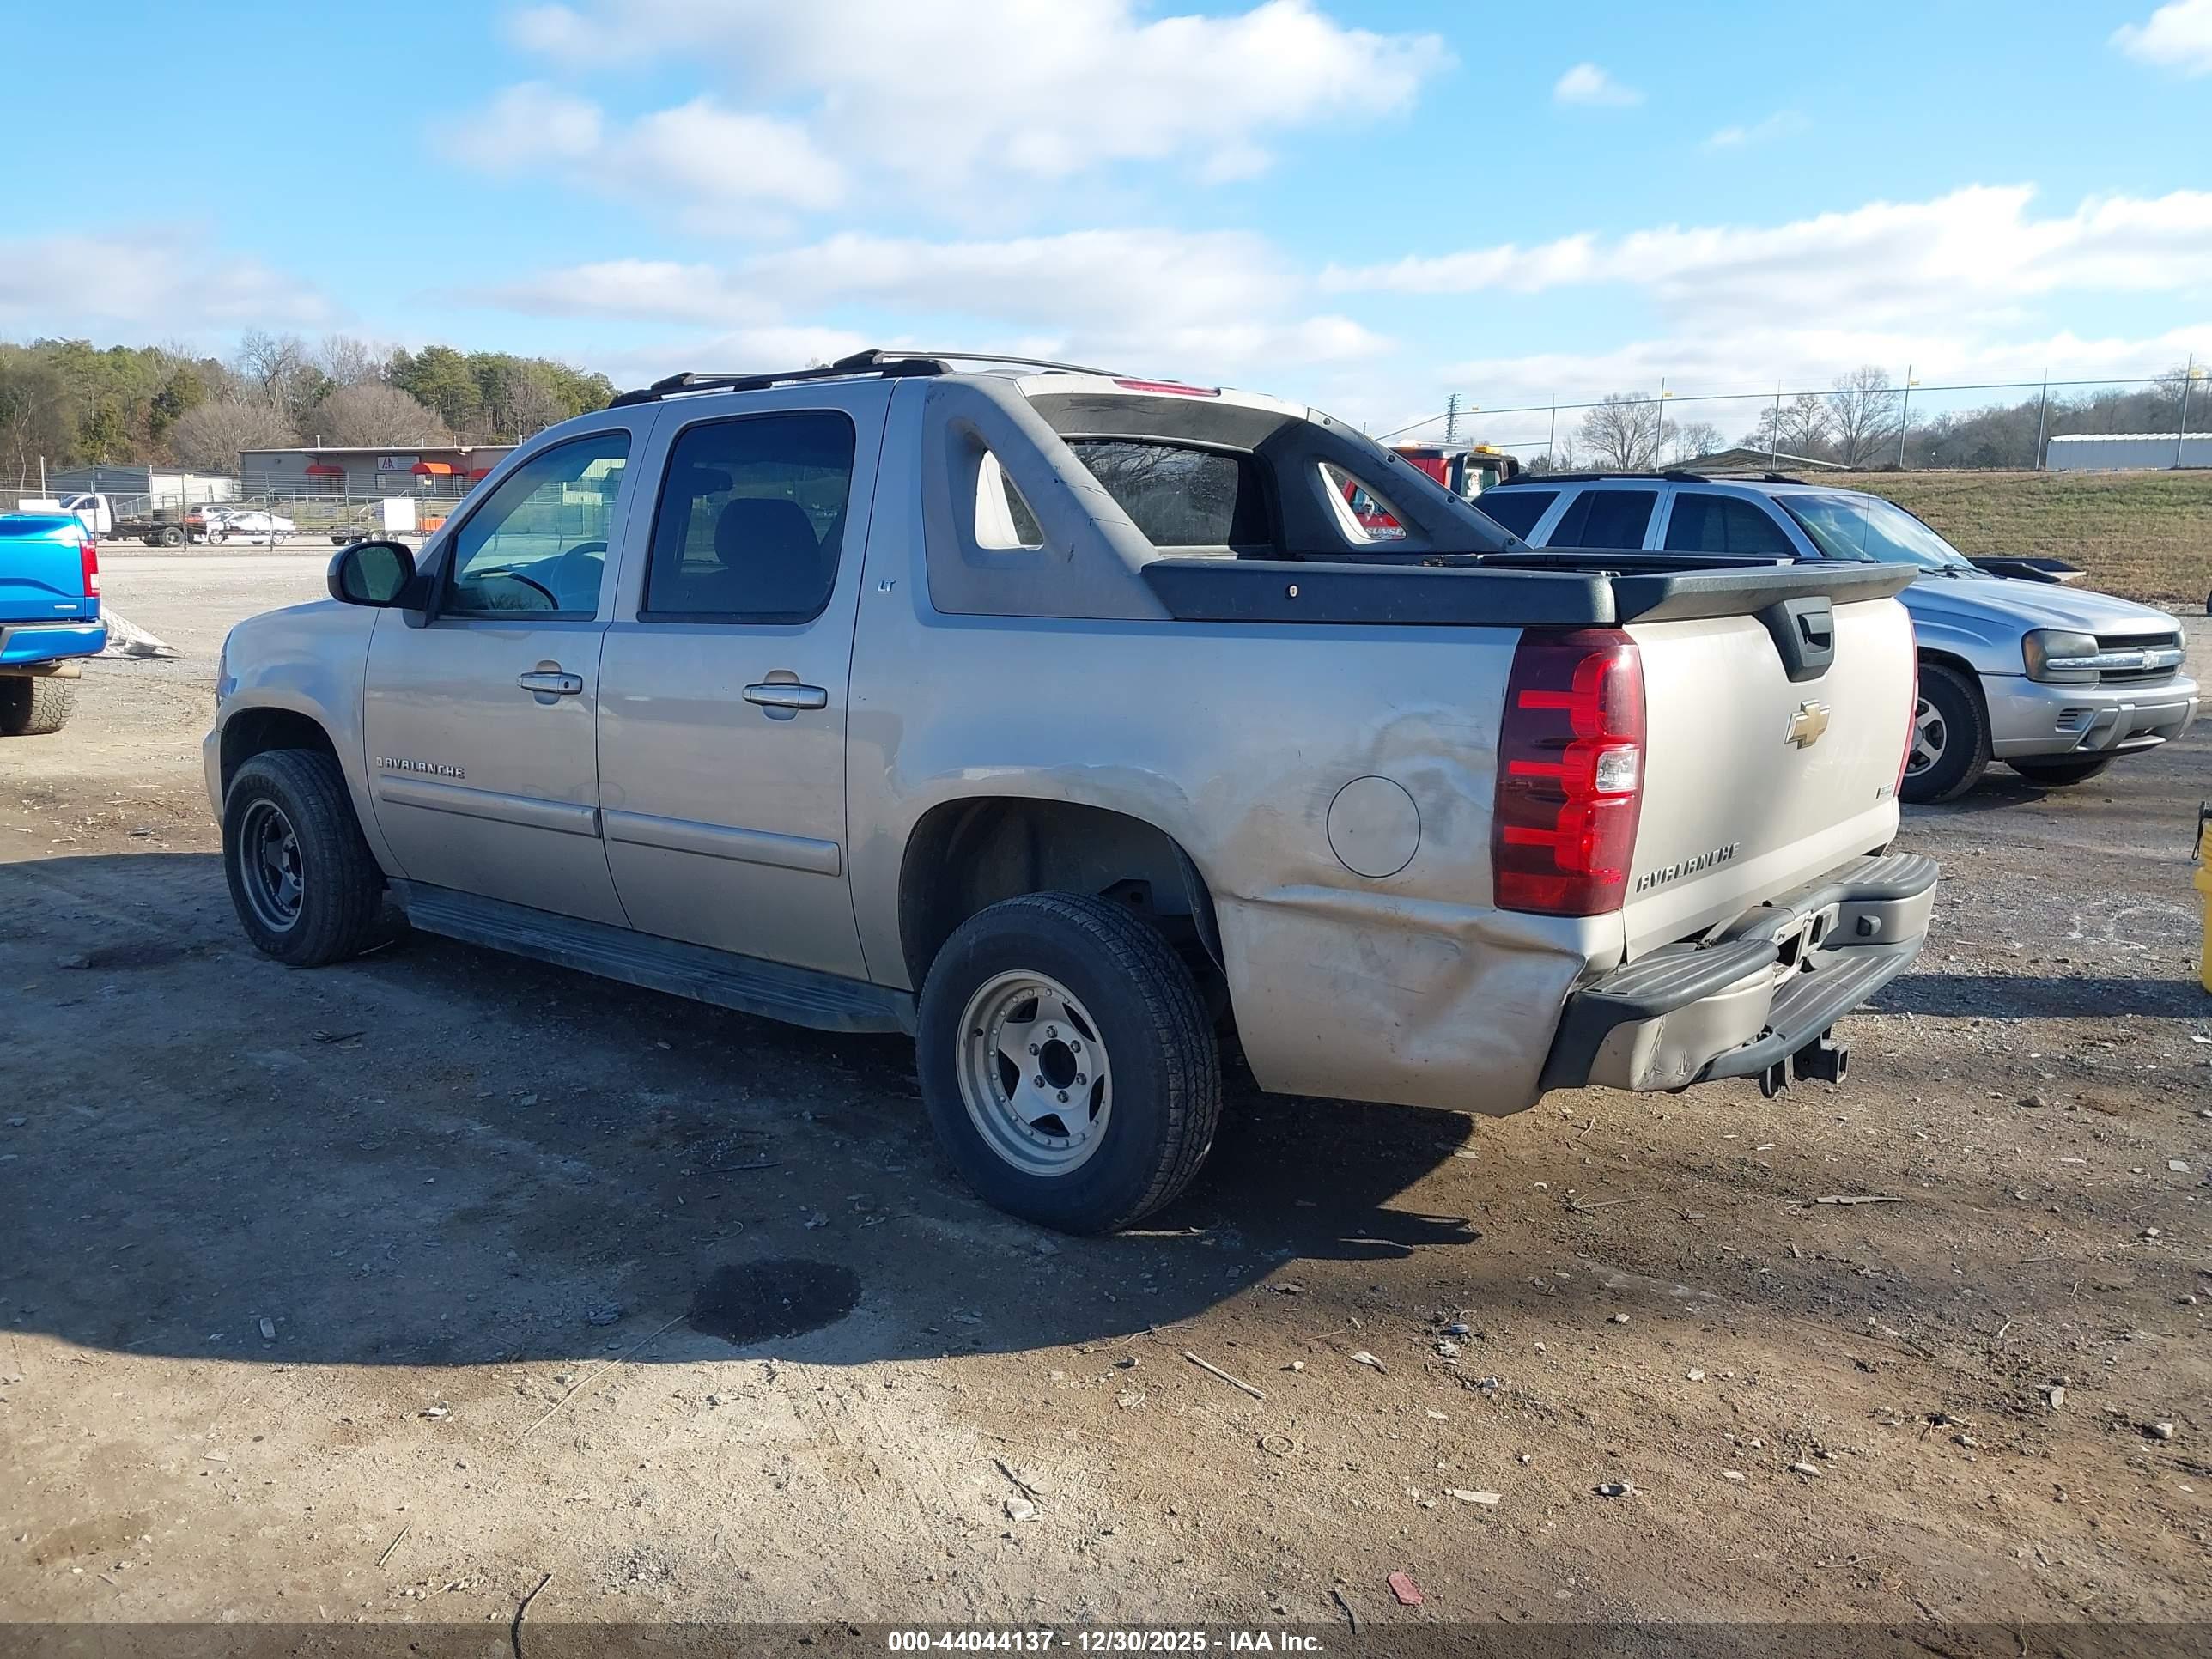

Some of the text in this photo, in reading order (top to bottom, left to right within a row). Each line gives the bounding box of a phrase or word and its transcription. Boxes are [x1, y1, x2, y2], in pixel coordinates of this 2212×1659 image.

[1365, 527, 1404, 537] SUNSE
[877, 580, 896, 593] LT
[385, 757, 465, 779] AVALANCHE
[1636, 842, 1741, 893] AVALANCHE
